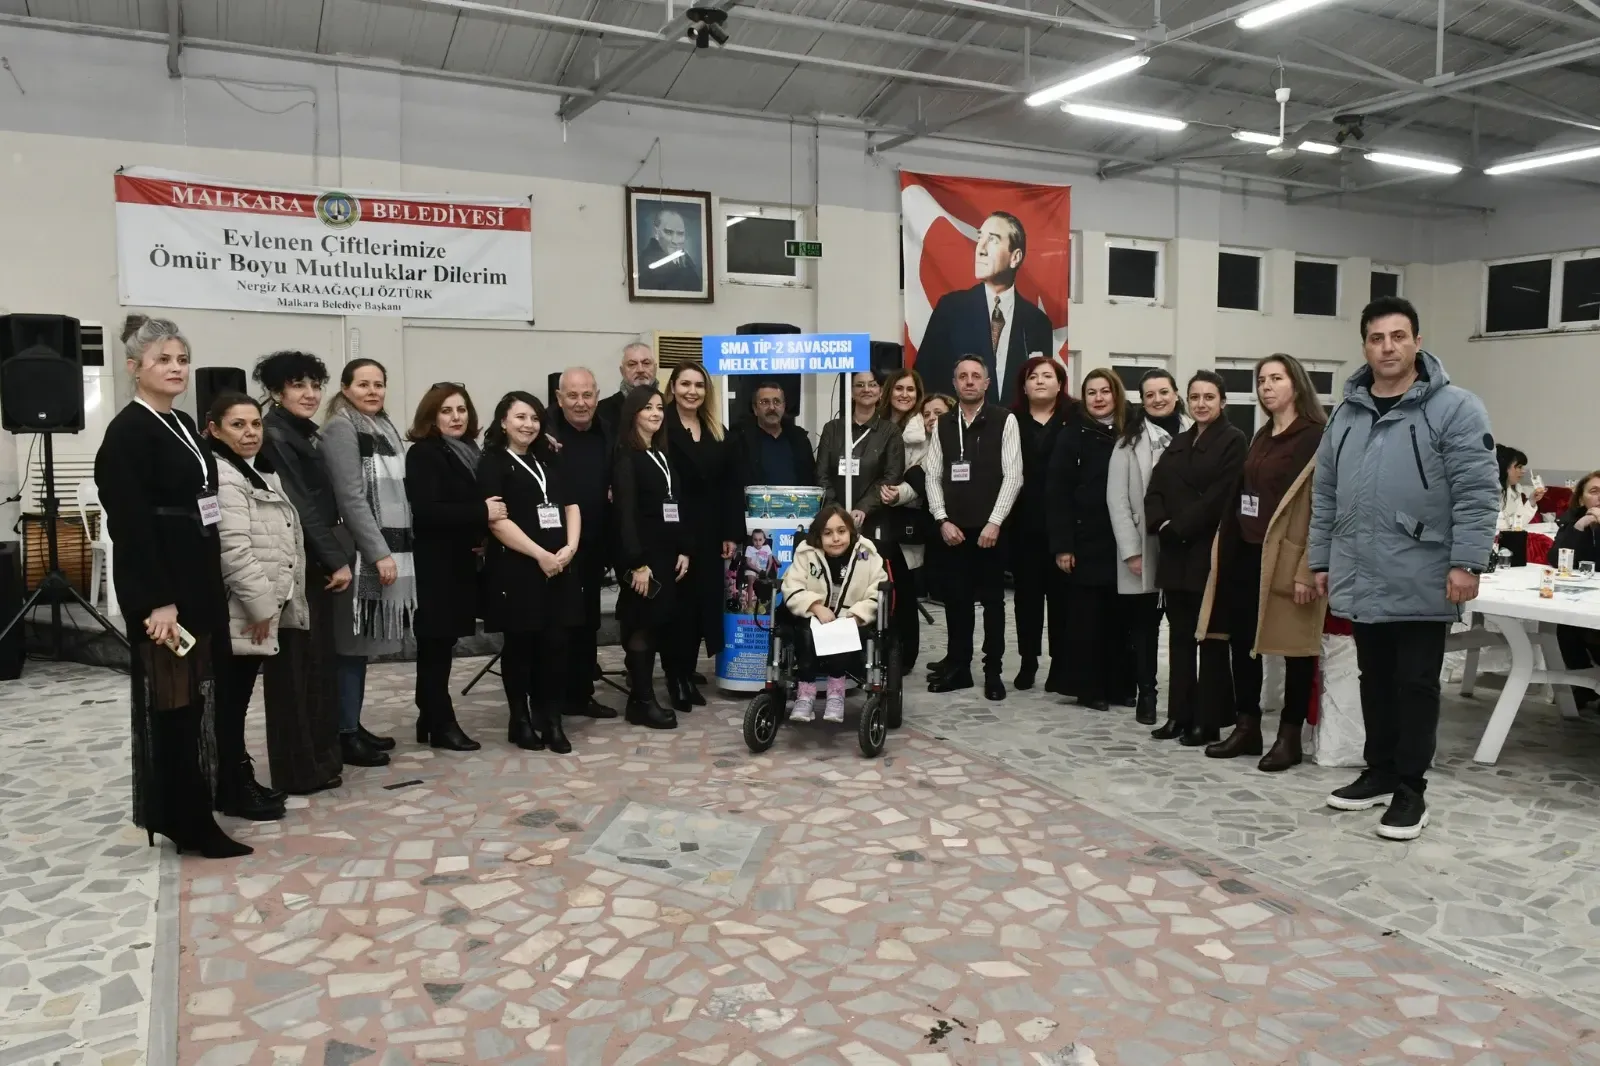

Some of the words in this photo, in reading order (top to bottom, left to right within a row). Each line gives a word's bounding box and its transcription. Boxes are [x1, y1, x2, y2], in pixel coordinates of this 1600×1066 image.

[171, 186, 304, 213] MALKARA
[372, 202, 505, 227] BELEDİYESİ
[222, 228, 313, 252] Evlenen
[321, 234, 447, 259] Çiftlerimize
[149, 243, 222, 270] Ömür
[228, 252, 287, 278] Boyu
[296, 257, 428, 282] Mutluluklar
[433, 264, 508, 285] Dilerim
[236, 279, 277, 294] Nergiz
[281, 282, 374, 299] KARAAĞAÇLI
[378, 284, 433, 299] ÖZTÜRK
[277, 297, 319, 309] Malkara
[322, 300, 362, 312] Belediye
[364, 301, 402, 313] Başkanı
[720, 341, 749, 355] SMA
[752, 338, 784, 355] TİP-2
[787, 340, 852, 356] SAVAŞÇISI
[718, 358, 769, 371] MELEK'E
[771, 357, 806, 371] UMUT
[809, 356, 854, 370] OLALIM
